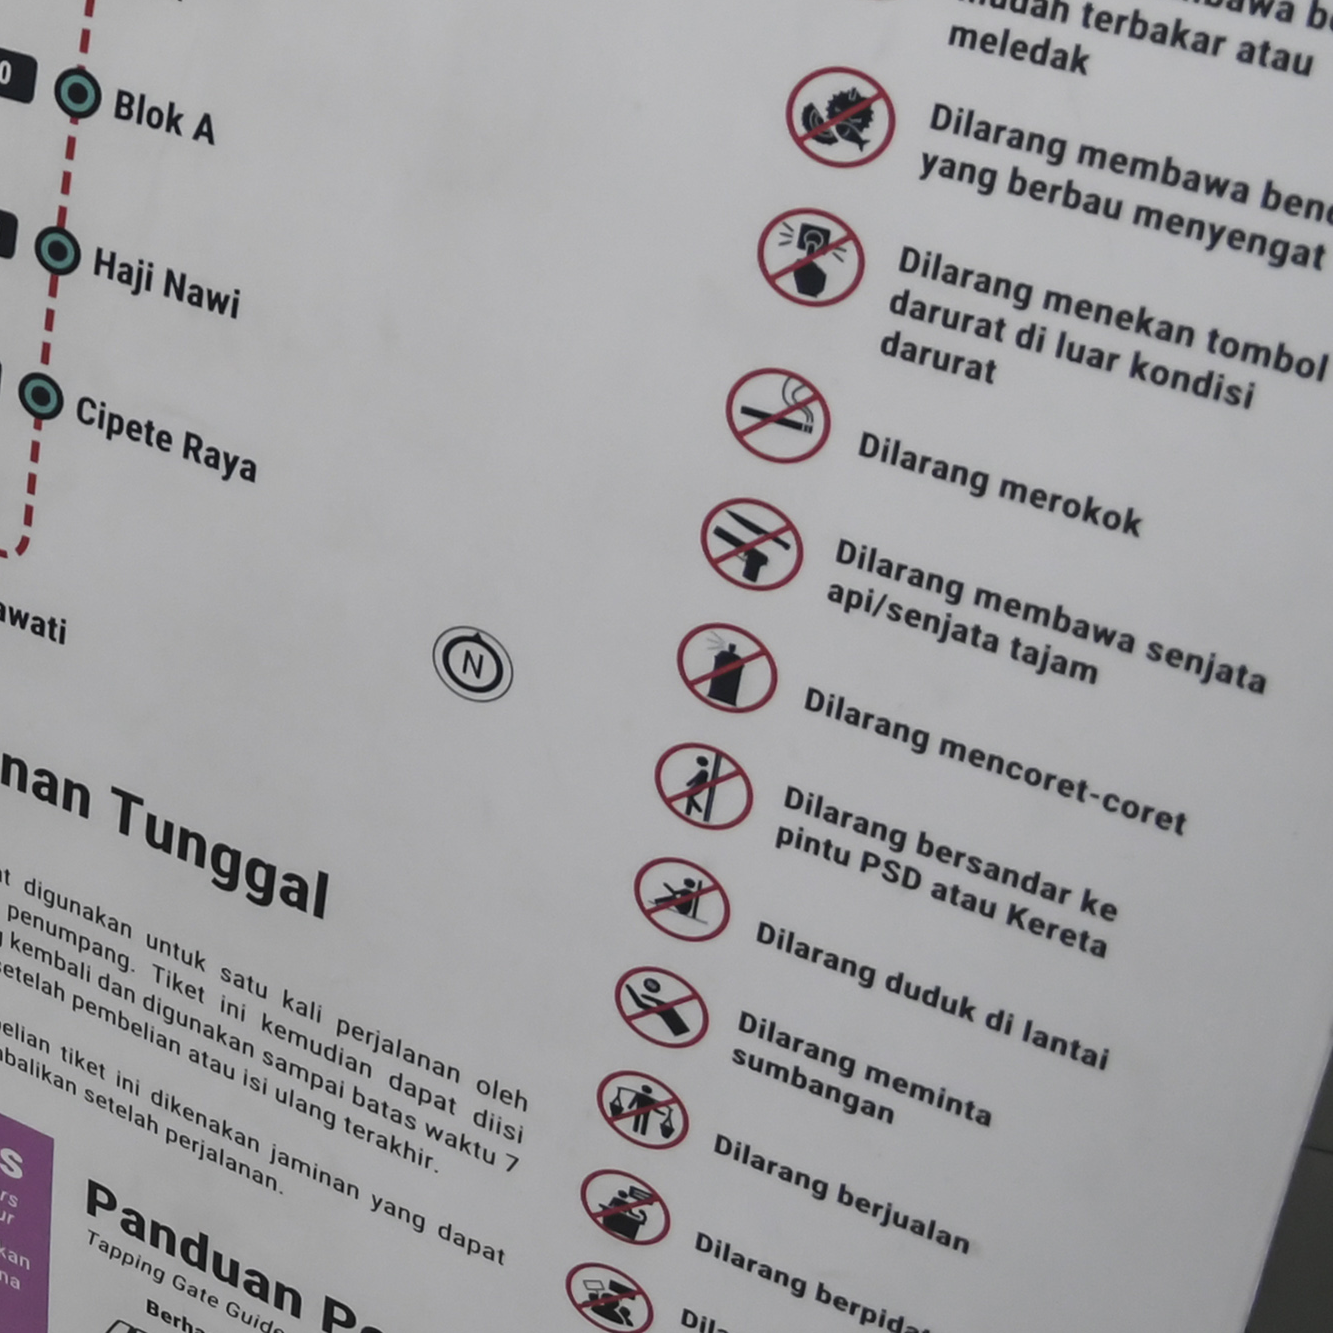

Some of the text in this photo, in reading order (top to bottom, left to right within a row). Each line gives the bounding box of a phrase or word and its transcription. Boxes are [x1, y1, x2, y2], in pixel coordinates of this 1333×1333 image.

[948, 25, 1090, 76] meledak
[1081, 2, 1228, 57] terbakar
[1235, 40, 1314, 78] atau
[113, 88, 215, 146] Blok A
[929, 102, 1250, 205] Dilarang membawa
[918, 152, 1327, 272] yang berbau menyengat
[93, 246, 241, 320] Haji Nawi
[898, 245, 1330, 383] Dilarang menekan tombol
[880, 330, 997, 385] darurat
[889, 288, 1256, 410] darurat di luar kondisi
[76, 396, 257, 484] Cipete Raya
[858, 431, 1143, 538] Dilarang merokok
[462, 649, 484, 680] N
[827, 583, 1099, 685] api/senjata tajam
[835, 538, 1267, 696] Dilarang membawa senjata
[804, 686, 1187, 837] Dilarang mencoret-coret
[110, 785, 330, 920] Tunggal
[775, 825, 1108, 959] pintu PSD atau Kereta
[783, 785, 1118, 923] Dilarang bersandar ke
[23, 877, 132, 939] digunakan
[146, 933, 206, 973] untuk
[220, 967, 268, 1000] satu
[282, 988, 322, 1024] kali
[335, 1018, 461, 1084] perjalanan
[476, 1079, 528, 1113] oleh
[756, 921, 1110, 1071] Dilarang duduk di lantai
[71, 993, 181, 1056] pembelian
[188, 1048, 236, 1081] atau
[242, 1068, 268, 1096] isi
[275, 1087, 337, 1131] ulang
[343, 1116, 439, 1174] terakhir.
[731, 1048, 895, 1125] sumbangan
[738, 1010, 992, 1128] Dilarang meminta
[84, 1088, 159, 1135] setelah
[165, 1127, 284, 1195] perjalanan.
[713, 1133, 970, 1255] Dilarang berjualan
[86, 1178, 303, 1320] Panduan
[87, 1228, 219, 1309] Tapping Gate
[694, 1231, 807, 1299] Dilarang
